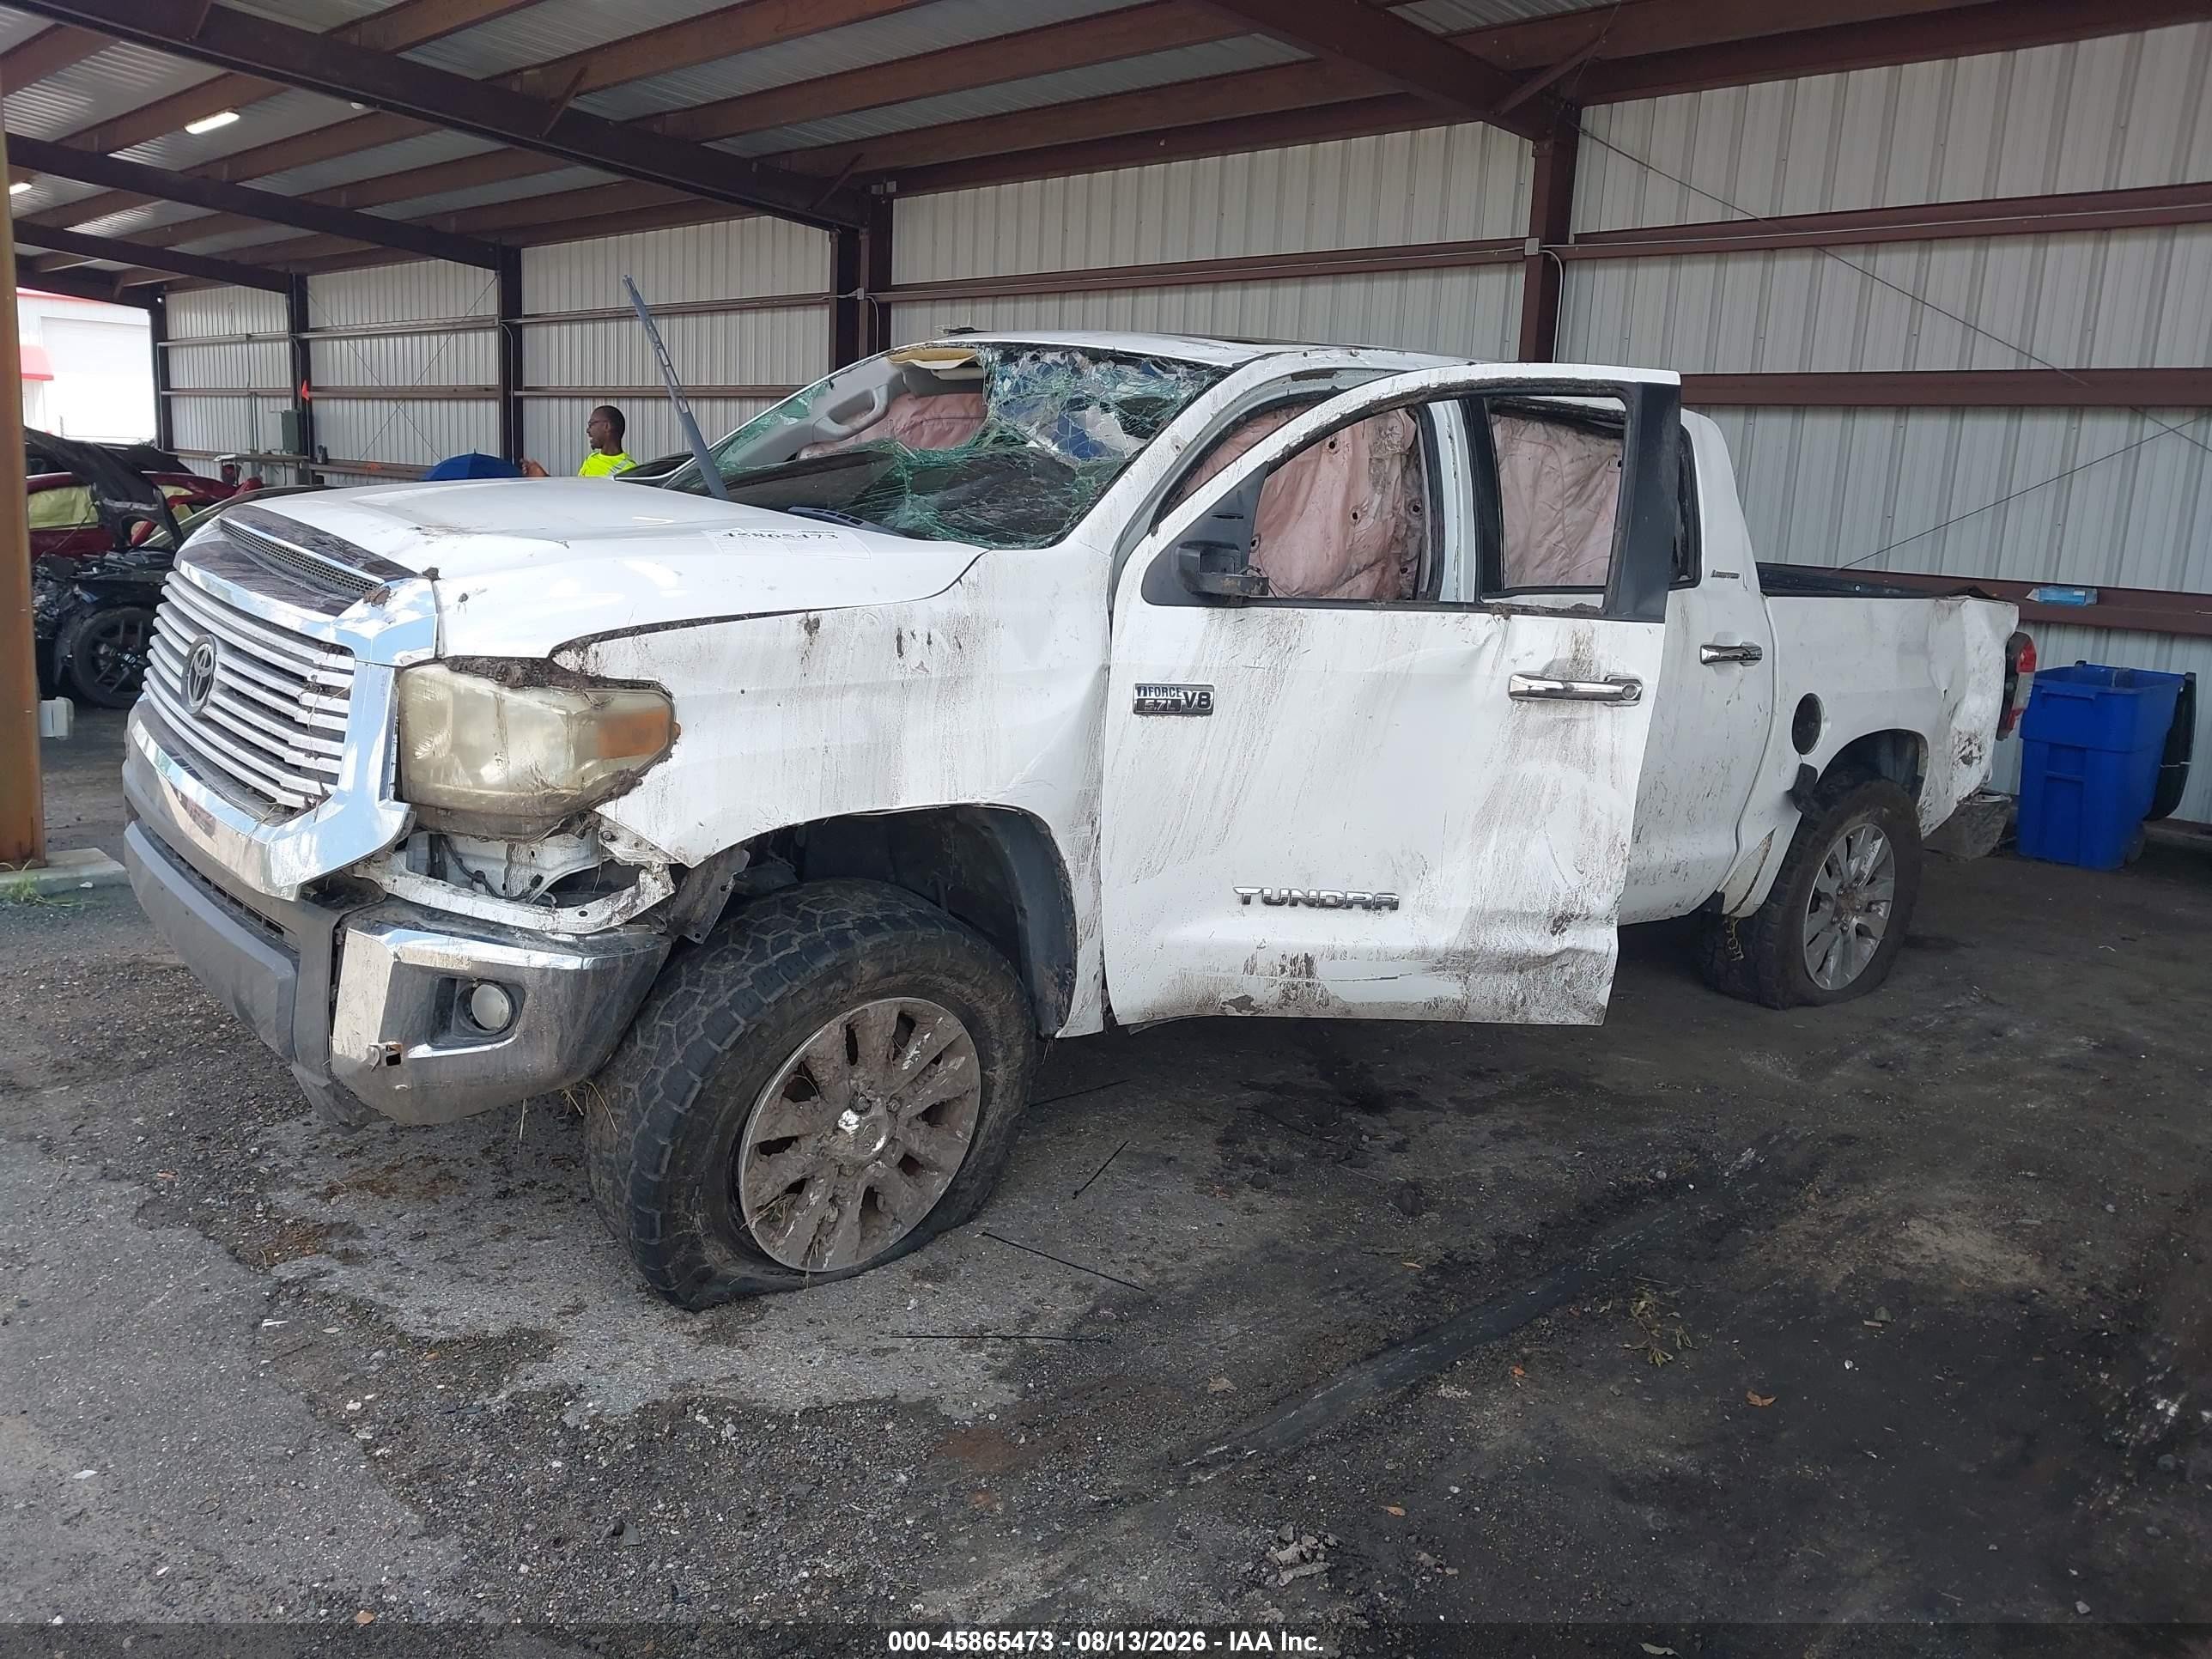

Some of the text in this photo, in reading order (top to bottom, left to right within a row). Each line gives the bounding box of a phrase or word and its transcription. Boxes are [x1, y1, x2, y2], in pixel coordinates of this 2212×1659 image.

[1145, 699, 1176, 711] 5.7L
[1183, 690, 1212, 708] V8
[1233, 886, 1401, 910] TUNDRA
